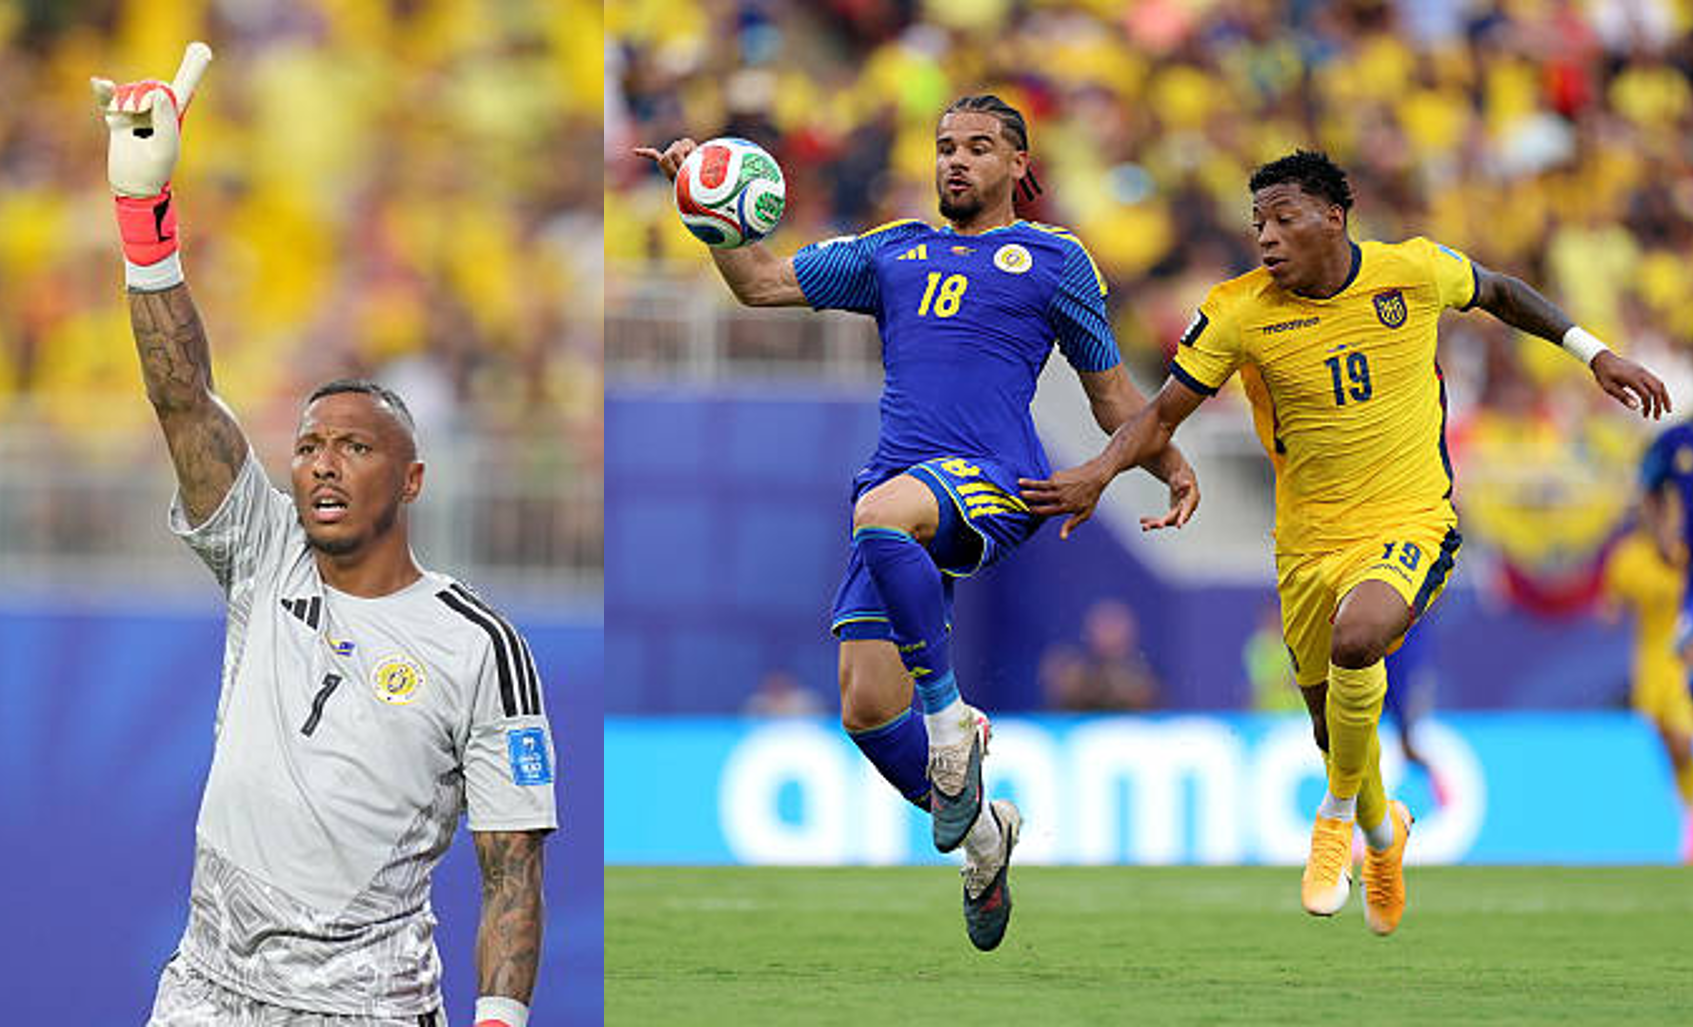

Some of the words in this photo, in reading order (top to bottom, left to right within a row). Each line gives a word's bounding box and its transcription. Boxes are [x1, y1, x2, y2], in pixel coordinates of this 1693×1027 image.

[918, 272, 968, 318] 18
[1325, 352, 1372, 406] 19
[300, 672, 343, 738] 1
